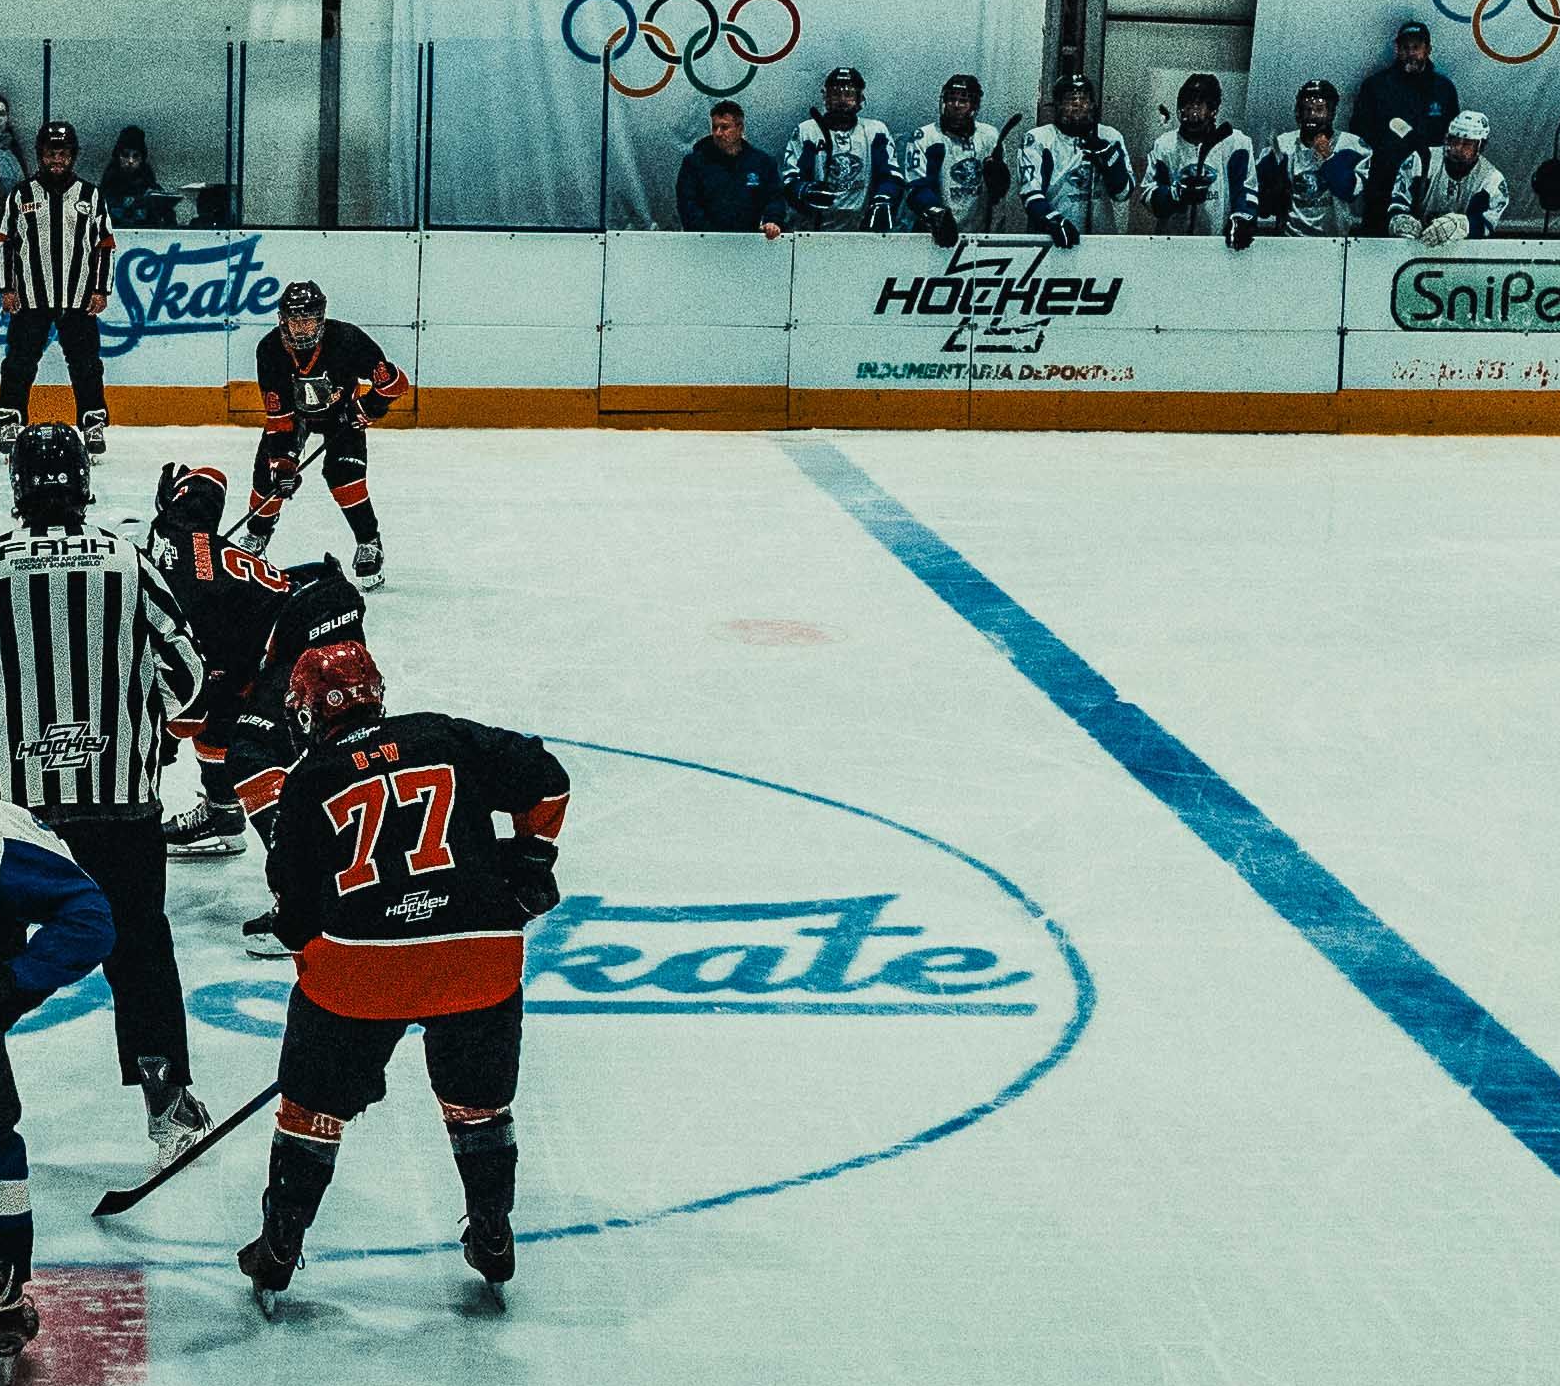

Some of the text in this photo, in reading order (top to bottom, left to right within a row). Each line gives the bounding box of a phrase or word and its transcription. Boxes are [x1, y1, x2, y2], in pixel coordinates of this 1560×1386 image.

[14, 559, 101, 571] HOCKEY SOBRE HIELO
[61, 554, 105, 562] ARGENTINA
[309, 609, 360, 641] BAUER
[322, 763, 456, 897] 77
